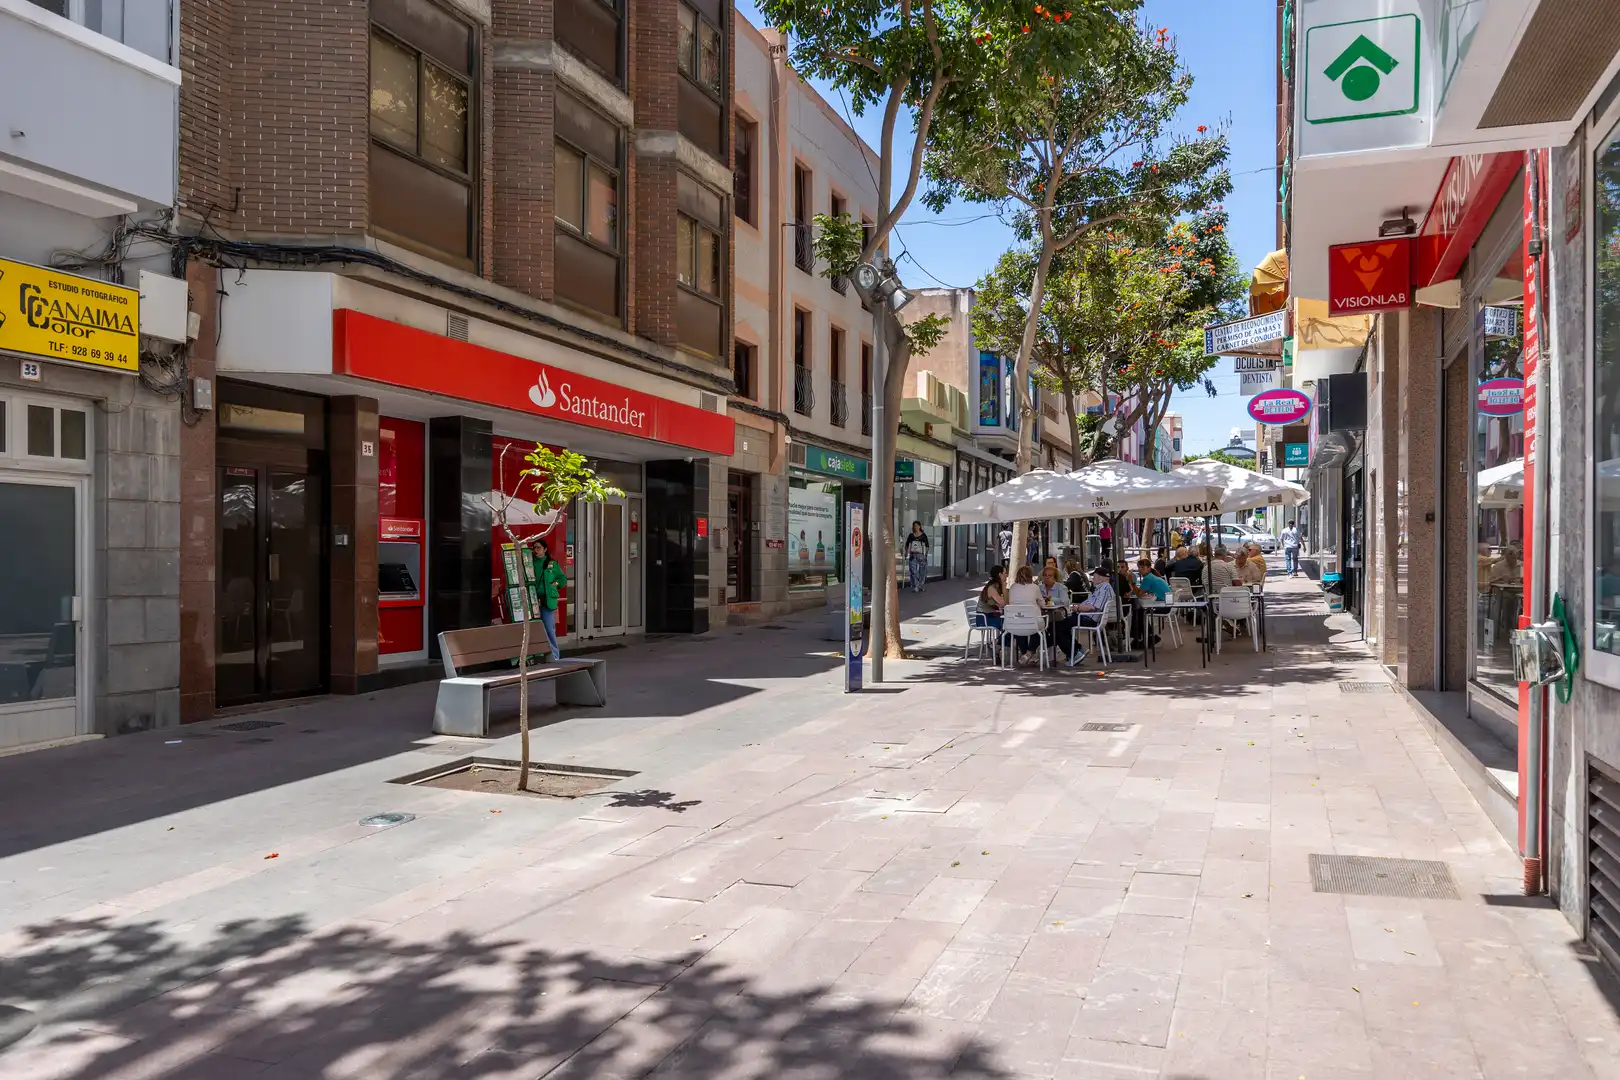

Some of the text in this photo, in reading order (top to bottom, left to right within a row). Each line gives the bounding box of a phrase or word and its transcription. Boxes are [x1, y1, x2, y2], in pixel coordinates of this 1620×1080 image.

[48, 279, 128, 305] ESTUDIO FOTOGRÁFICO
[1335, 292, 1406, 309] VISIONLAB
[1214, 312, 1284, 337] CENTRO DE RECONOCIMIENTO
[1216, 333, 1243, 344] PERMISO
[1254, 325, 1276, 335] ARMAS
[1216, 341, 1240, 352] CARNET
[1250, 330, 1282, 344] CONDUCIR
[48, 341, 128, 364] TLF: 928 69 39 44
[24, 363, 38, 376] 33
[1236, 357, 1274, 370] OCULISTA
[1242, 373, 1273, 384] DENTISTA
[559, 382, 646, 428] Santander
[1275, 398, 1294, 406] Real
